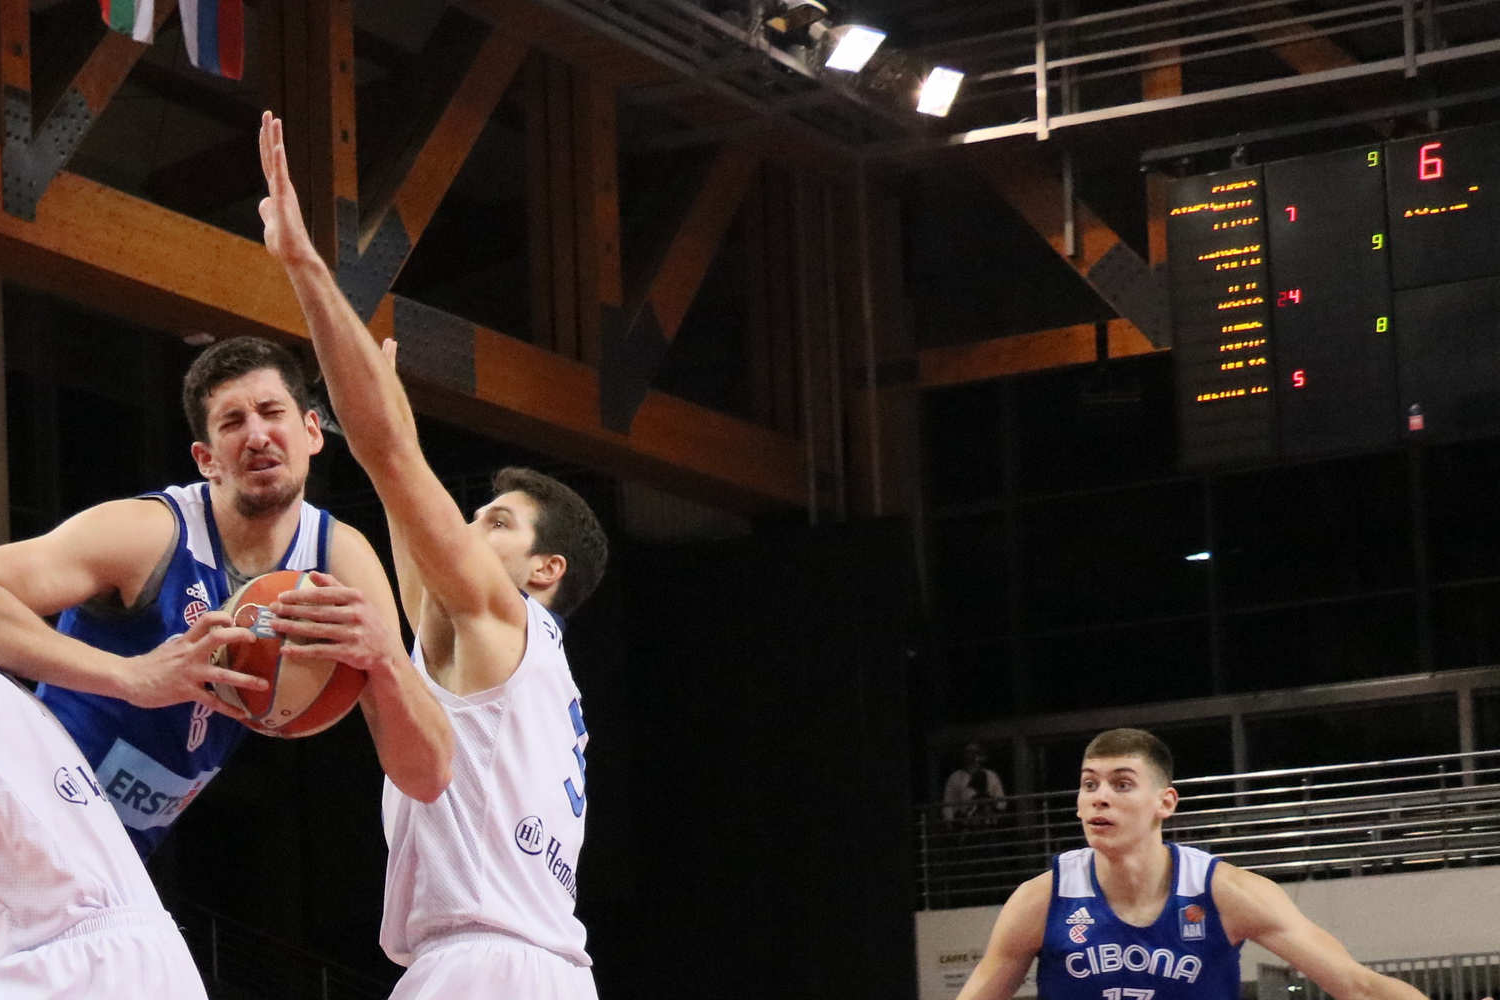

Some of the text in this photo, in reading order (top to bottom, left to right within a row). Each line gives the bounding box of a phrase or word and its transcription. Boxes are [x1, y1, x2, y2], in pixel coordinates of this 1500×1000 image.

[1367, 151, 1378, 167] 9
[1419, 142, 1443, 181] 6
[1285, 206, 1297, 222] 7
[1371, 234, 1383, 250] 9
[1376, 316, 1388, 333] 8
[1065, 944, 1202, 984] CIBONA
